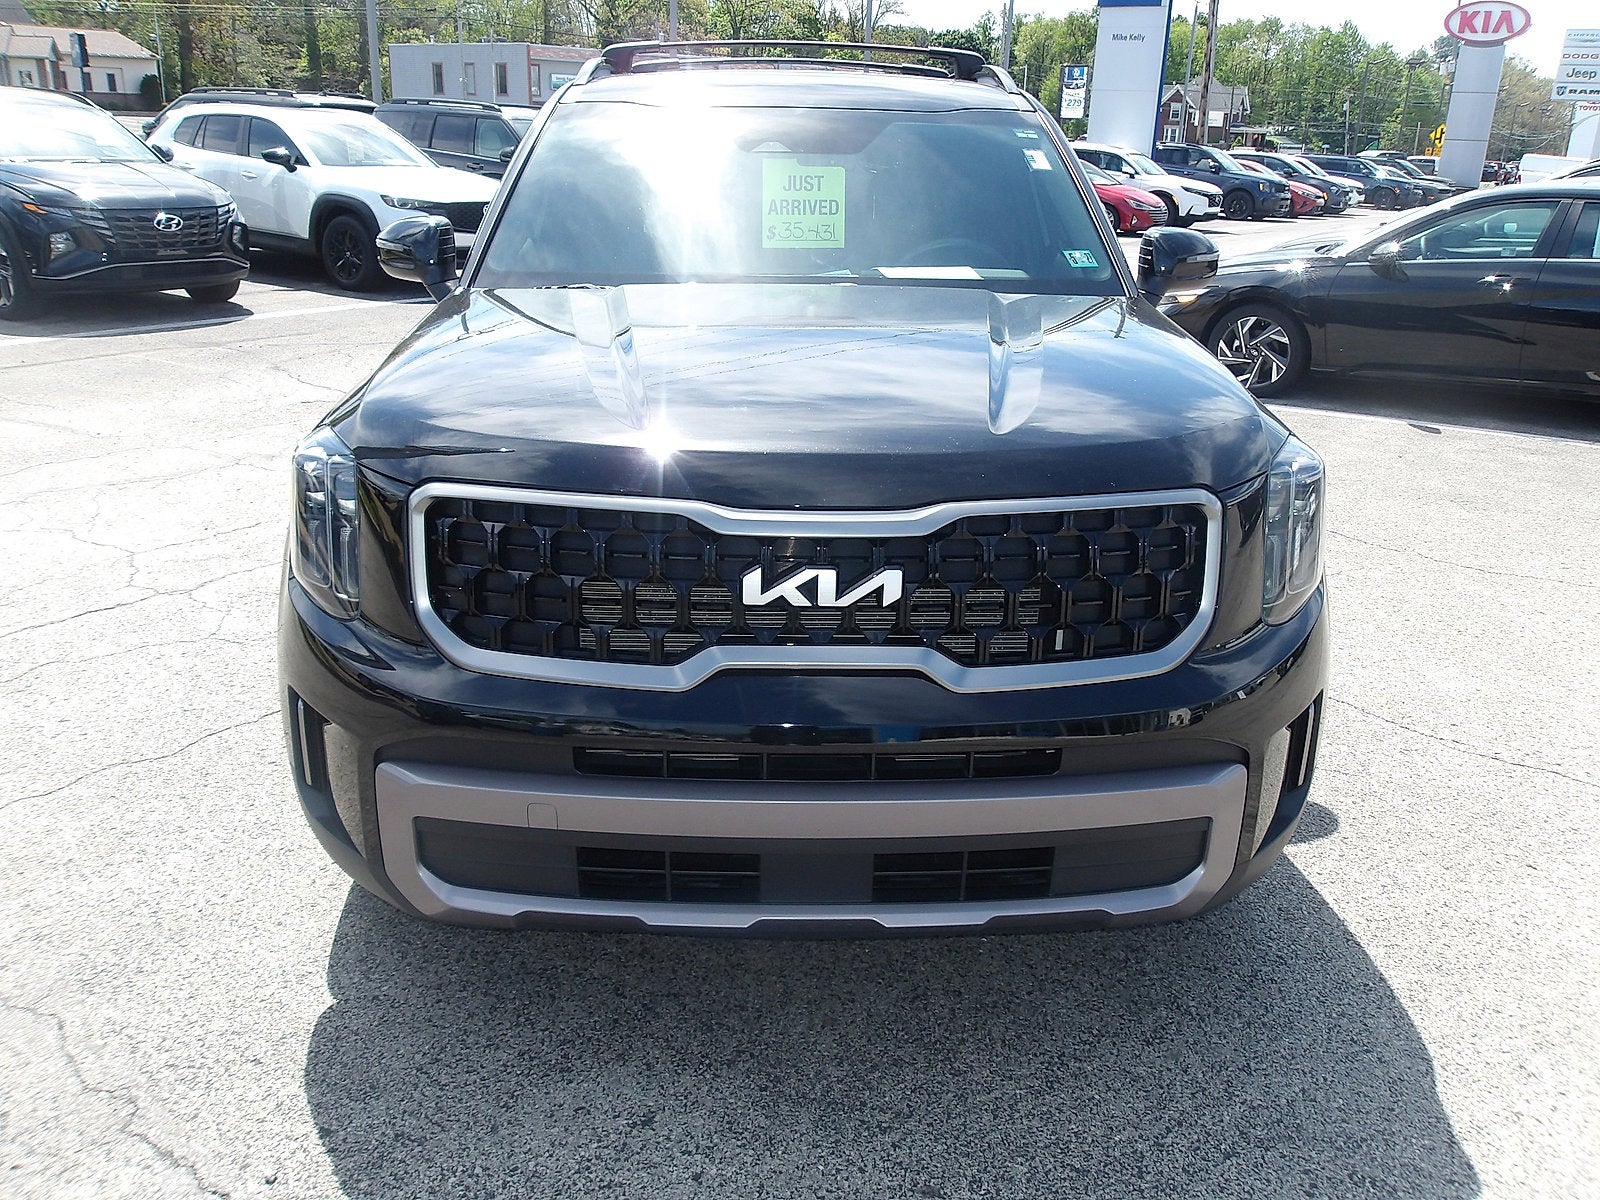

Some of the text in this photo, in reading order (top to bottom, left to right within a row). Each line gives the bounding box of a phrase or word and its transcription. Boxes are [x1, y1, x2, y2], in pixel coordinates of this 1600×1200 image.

[1458, 10, 1514, 33] KIA
[1111, 33, 1146, 43] Mike Kelly
[1566, 67, 1597, 80] Jeep
[782, 174, 825, 192] JUST
[767, 198, 840, 216] ARRIVED
[739, 563, 904, 608] KIA
